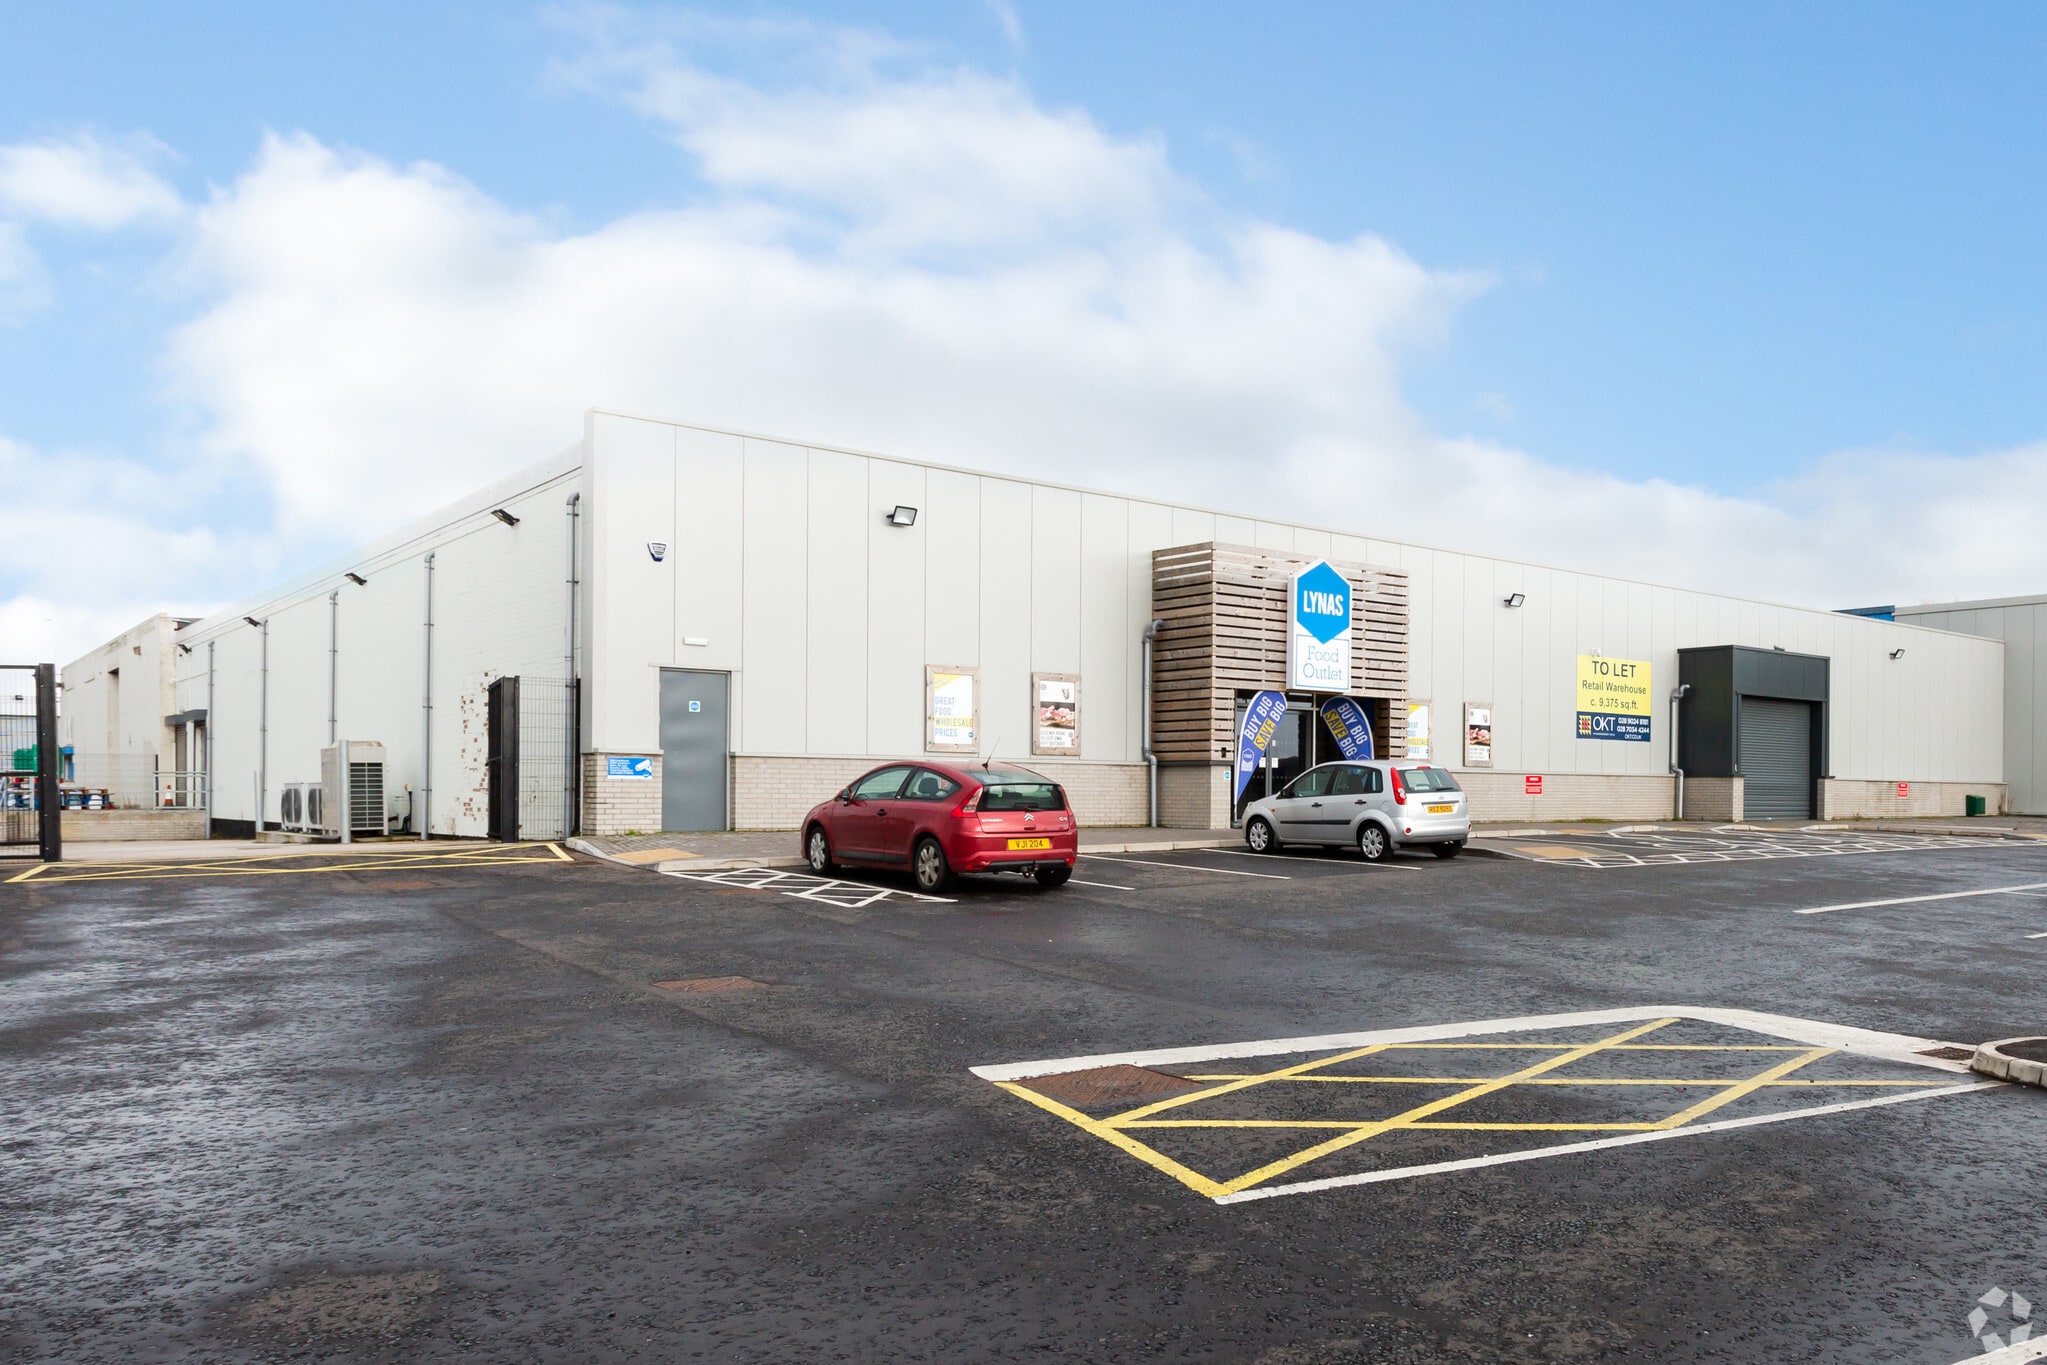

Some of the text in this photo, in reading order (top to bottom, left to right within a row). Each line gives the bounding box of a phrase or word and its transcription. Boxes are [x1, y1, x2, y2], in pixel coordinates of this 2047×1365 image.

[1304, 590, 1344, 616] LYNAS
[1307, 646, 1339, 662] Food
[1303, 662, 1342, 680] Outlet
[1592, 661, 1636, 678] TO LET
[1582, 680, 1647, 694] Retail Warehouse
[934, 696, 955, 705] GREAT
[1599, 698, 1619, 708] 9,375
[934, 706, 952, 716] FOOD
[1244, 715, 1261, 740] BUY
[1256, 696, 1273, 717] BIG
[934, 717, 974, 727] WHOLESALE
[1255, 701, 1285, 748] SAVE BIG
[1337, 703, 1368, 744] BUY BIG
[1592, 716, 1616, 731] OKT
[934, 728, 958, 737] PRICES
[1325, 710, 1358, 756] SAVE BIG
[1029, 840, 1043, 848] 204
